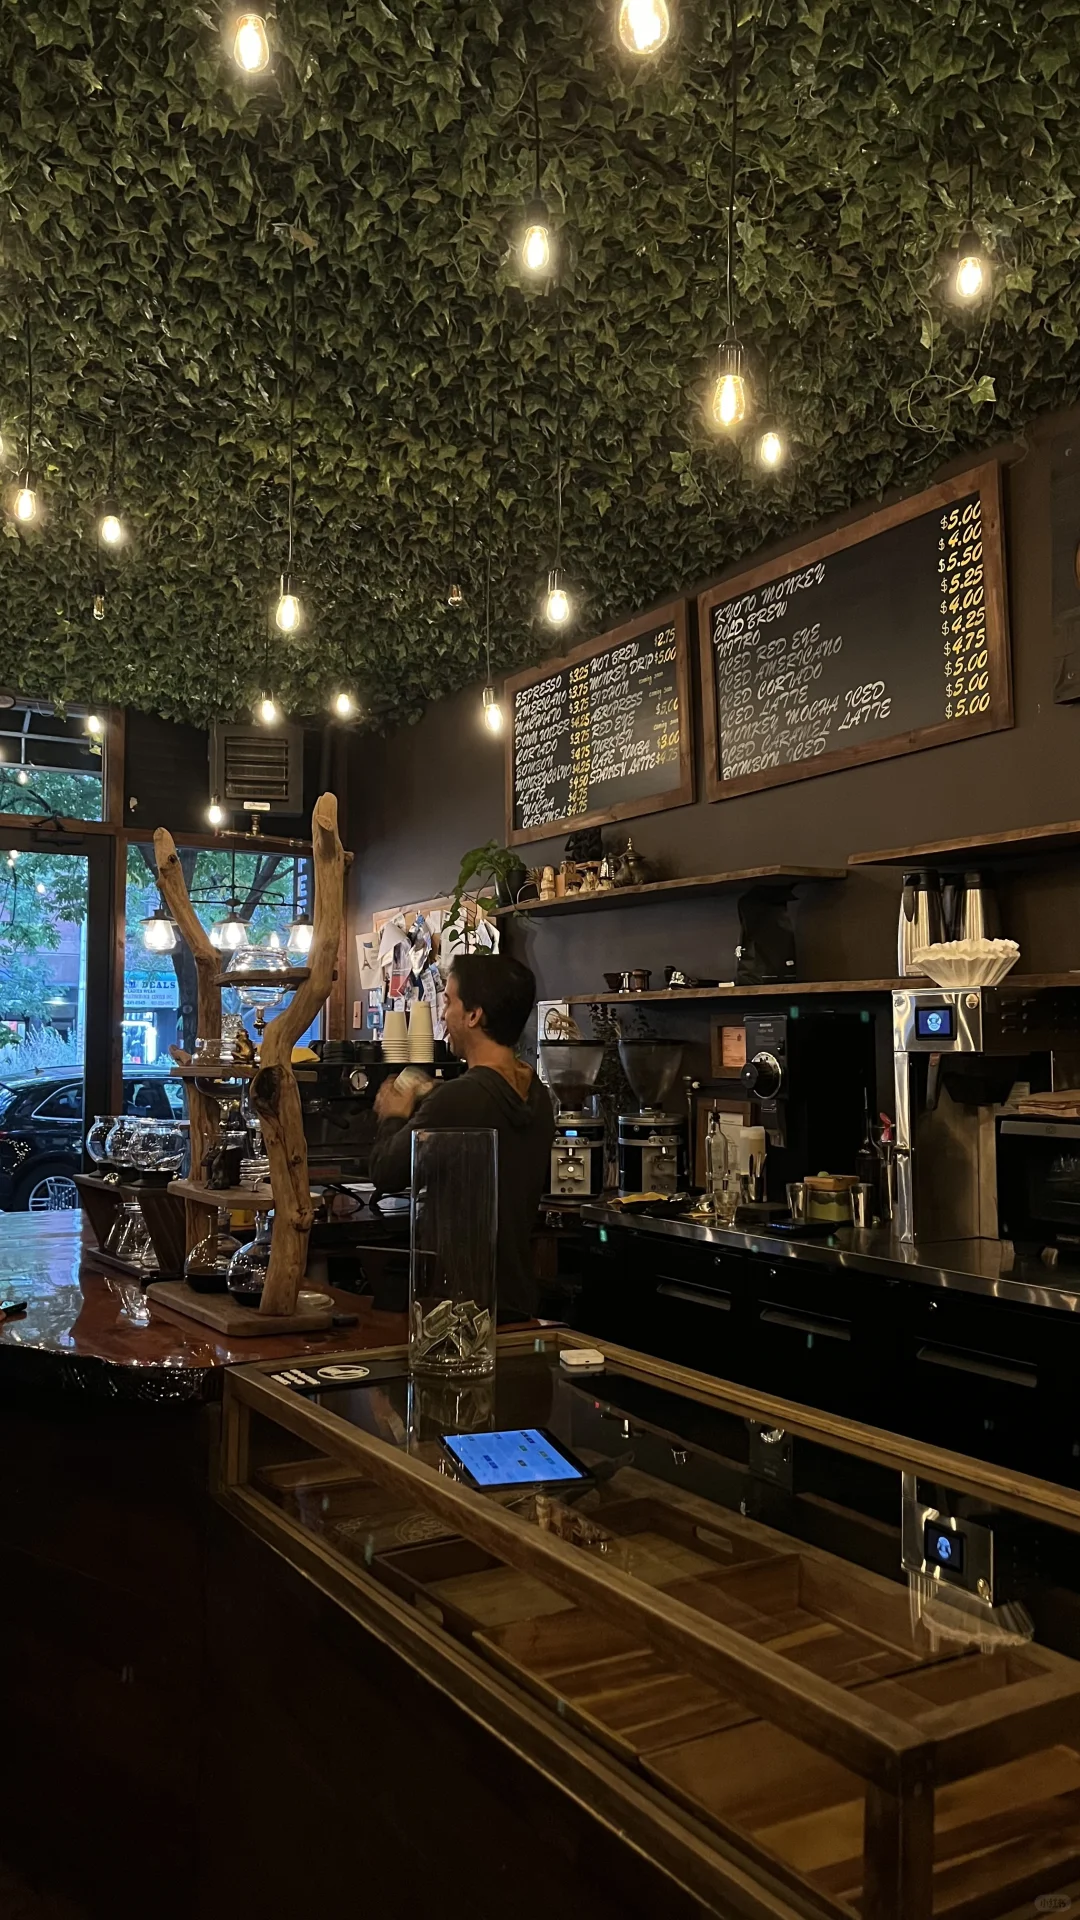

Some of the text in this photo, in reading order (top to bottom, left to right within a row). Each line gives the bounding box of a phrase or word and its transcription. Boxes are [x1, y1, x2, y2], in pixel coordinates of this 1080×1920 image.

[714, 500, 981, 625] KYOTO MONKEY $5.00
[713, 520, 982, 643] COLD BREW $4.00
[717, 541, 983, 658] NITRO $5.50
[719, 564, 984, 677] ICED RED EYE $5.25
[590, 628, 676, 674] HOT BREW $2.75
[719, 586, 984, 693] ICED AMERICANO $4.00
[589, 646, 677, 691] MONKEY DRIP $5.00
[719, 606, 985, 711] ICED CORTADO $4.25
[515, 675, 562, 707] ESPRESSO
[590, 680, 629, 707] SIPHON
[720, 627, 985, 728] ICED LATTE $4.75
[514, 690, 567, 722] AMERICANO
[590, 691, 644, 724] AEROPRESS
[721, 649, 988, 746] MONKEY MOCHA ICED $5.00
[591, 719, 613, 739] RED
[614, 710, 636, 732] EYE
[721, 671, 989, 765] ICED CARAMEL LATTE $5.00
[515, 730, 538, 750] DOWN
[515, 738, 558, 765] CORTADO
[591, 729, 634, 754] TURKISH
[722, 692, 990, 781] BOMBON ICED $5.00
[516, 754, 554, 779] BOMBON
[591, 749, 615, 770] CAFE
[628, 752, 656, 775] LATTE
[516, 786, 545, 805] LATTE
[522, 797, 555, 815] MOCHA
[522, 805, 566, 829] CARAMEL
[142, 981, 176, 989] DEALS
